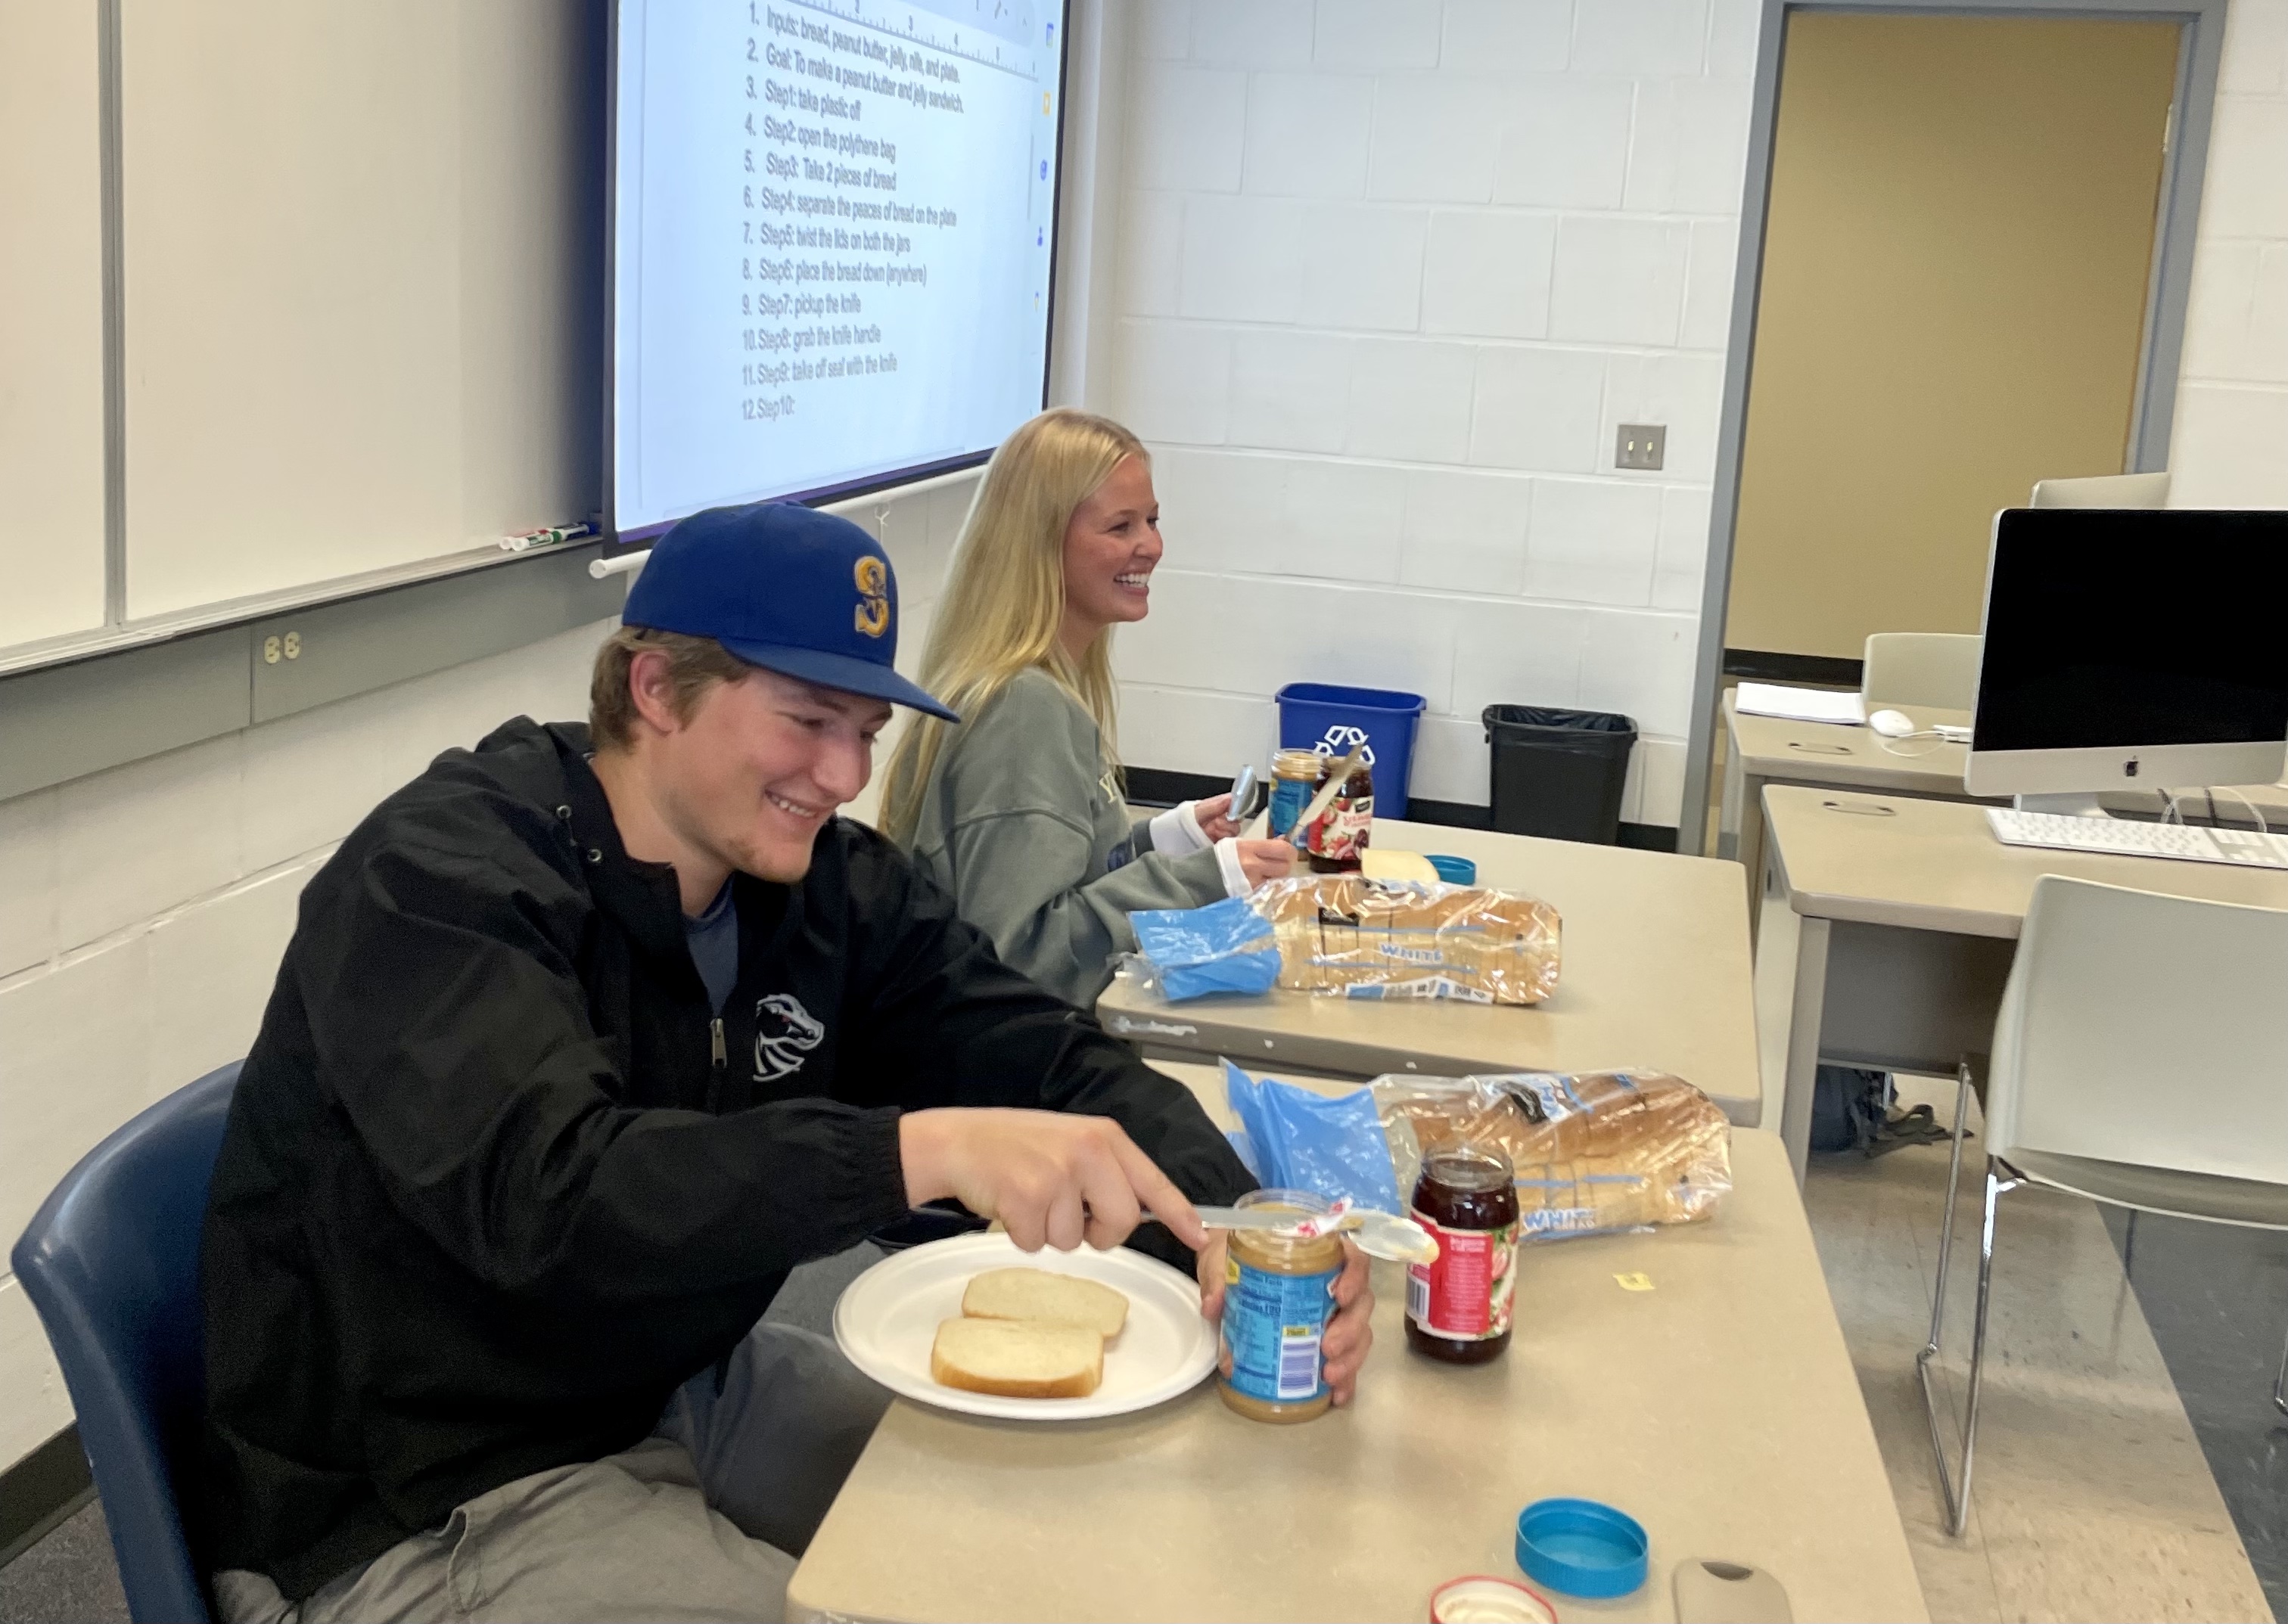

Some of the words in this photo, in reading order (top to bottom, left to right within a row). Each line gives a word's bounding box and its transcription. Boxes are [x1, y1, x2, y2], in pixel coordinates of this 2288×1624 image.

[750, 0, 760, 25] 1.
[767, 4, 798, 37] Inputs:
[832, 29, 861, 56] peanut
[925, 57, 940, 78] and
[747, 37, 758, 62] 2.
[766, 42, 792, 71] Goal:
[794, 48, 806, 75] To
[807, 57, 832, 82] make
[835, 65, 841, 83] a
[842, 67, 871, 90] peanut
[872, 70, 897, 97] butter
[897, 80, 912, 101] and
[912, 81, 928, 109] jelly
[746, 74, 757, 100] 3.
[765, 77, 797, 110] Step1:
[798, 86, 819, 113] take
[820, 92, 849, 119] plastic
[849, 99, 862, 121] off
[745, 112, 757, 137] 4.
[763, 114, 797, 147] Step2:
[797, 126, 821, 150] open
[823, 127, 838, 151] the
[838, 131, 878, 159] polythene
[880, 137, 897, 165] bag
[744, 147, 755, 173] 5.
[766, 151, 799, 182] Step3:
[802, 157, 825, 182] Take
[826, 160, 832, 183] 2
[834, 163, 862, 188] pieces
[863, 166, 872, 188] of
[872, 168, 897, 191] bread
[743, 185, 755, 209] 6.
[797, 194, 835, 219] separate
[837, 194, 850, 218] the
[883, 200, 893, 222] of
[893, 200, 915, 224] bread
[916, 207, 925, 225] on
[926, 205, 938, 225] the
[939, 206, 957, 230] plate
[743, 220, 754, 245] 7.
[796, 224, 817, 248] twist
[819, 226, 832, 250] the
[834, 228, 849, 250] lids
[850, 232, 862, 250] on
[863, 229, 881, 252] both
[882, 231, 896, 252] the
[895, 232, 911, 258] jars
[742, 257, 753, 281] 8.
[796, 259, 820, 286] place
[822, 259, 835, 282] the
[837, 260, 862, 282] bread
[863, 262, 885, 282] down
[886, 261, 928, 288] (anywhere)
[741, 293, 752, 316] 9.
[758, 293, 793, 320] Step7:
[794, 292, 825, 319] pickup
[825, 292, 839, 314] the
[840, 291, 862, 313] knife
[793, 325, 816, 353] grab
[817, 325, 831, 346] the
[832, 324, 852, 346] knife
[853, 323, 881, 345] handle
[742, 363, 757, 386] 11.
[792, 359, 814, 381] take
[815, 356, 828, 379] off
[828, 356, 846, 377] seal
[846, 354, 864, 376] with
[865, 354, 878, 374] the
[879, 351, 898, 373] knife
[1381, 942, 1443, 962] WHITE
